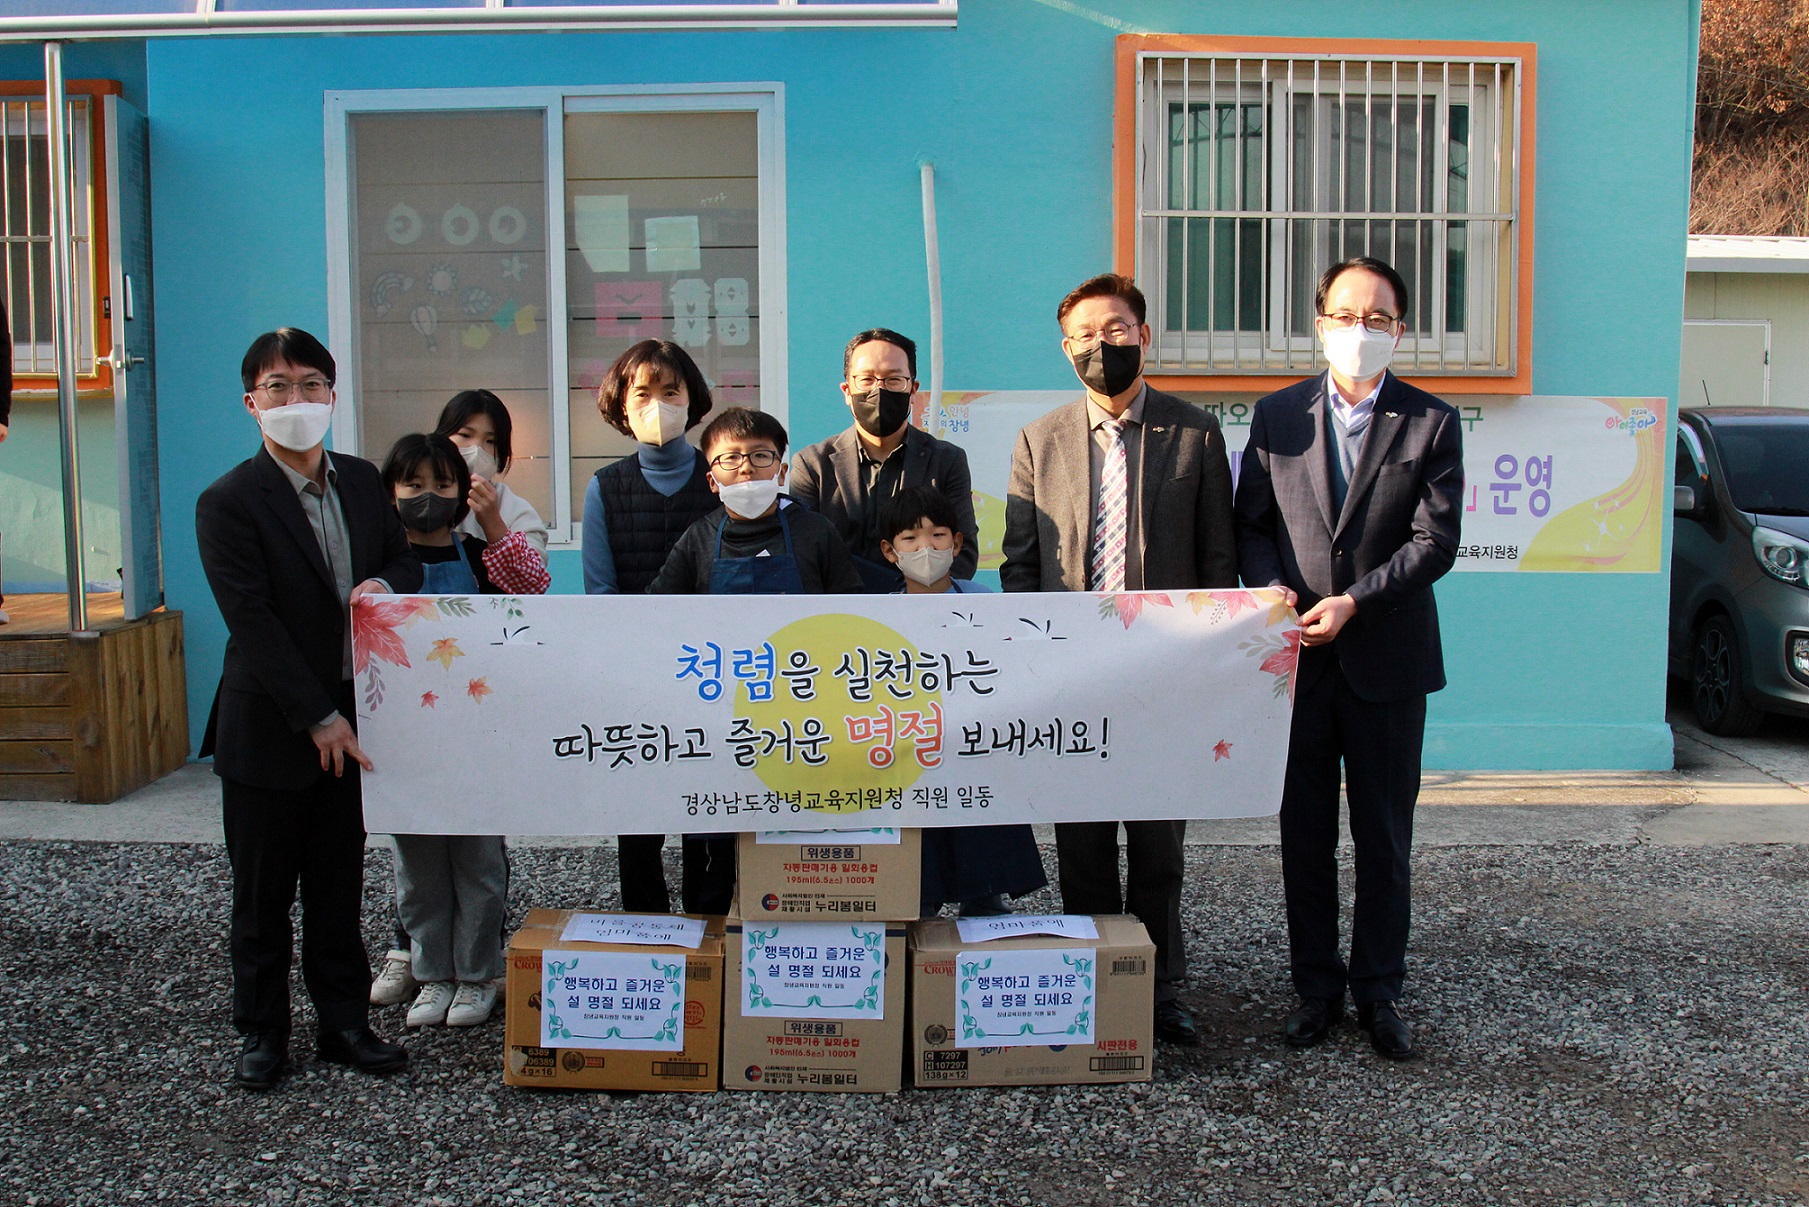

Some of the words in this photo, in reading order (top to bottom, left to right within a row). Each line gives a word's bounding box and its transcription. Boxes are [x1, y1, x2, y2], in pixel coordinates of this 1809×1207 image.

[1204, 401, 1251, 428] 따오
[949, 419, 969, 432] 창녕
[1604, 415, 1656, 436] 아이좋아
[1489, 453, 1553, 518] 운영
[1456, 545, 1519, 560] 교육지원청
[675, 641, 819, 702] 청렴을
[834, 648, 998, 700] 실천하는
[552, 723, 712, 769] 따뜻하고
[725, 718, 830, 768] 즐거운
[845, 703, 943, 767] 명절
[957, 717, 1108, 759] 보내세요!
[681, 786, 903, 816] 경상남도창녕교육지원청
[912, 786, 948, 810] 직원
[957, 785, 994, 809] 일동
[807, 848, 855, 859] 위생용품
[783, 863, 838, 874] 자동판매기용
[842, 863, 879, 874] 일회용컵
[846, 875, 875, 885] 1000개
[815, 900, 876, 912] 누리봄일터
[765, 945, 818, 961] 행복하고
[826, 946, 865, 962] 즐거운
[768, 964, 780, 979] 설
[788, 964, 815, 979] 명절
[822, 965, 862, 979] 되세요
[924, 965, 956, 974] CROW
[564, 976, 618, 992] 행복하고
[626, 978, 666, 993] 즐거운
[977, 974, 1030, 991] 행복하고
[1038, 974, 1077, 990] 즐거운
[567, 995, 580, 1009] 설
[588, 996, 614, 1011] 명절
[621, 997, 662, 1012] 되세요
[981, 994, 993, 1009] 설
[1001, 993, 1027, 1008] 명절
[1034, 992, 1074, 1007] 되세요
[790, 1022, 837, 1035] 위생용품
[766, 1035, 821, 1048] 자동판매기용
[824, 1036, 860, 1048] 일회용컵
[1097, 1039, 1138, 1051] 시판전용
[827, 1049, 857, 1058] 1000개
[940, 1052, 961, 1060] 7297
[935, 1061, 966, 1070] 107297
[797, 1073, 857, 1085] 누리봄일터
